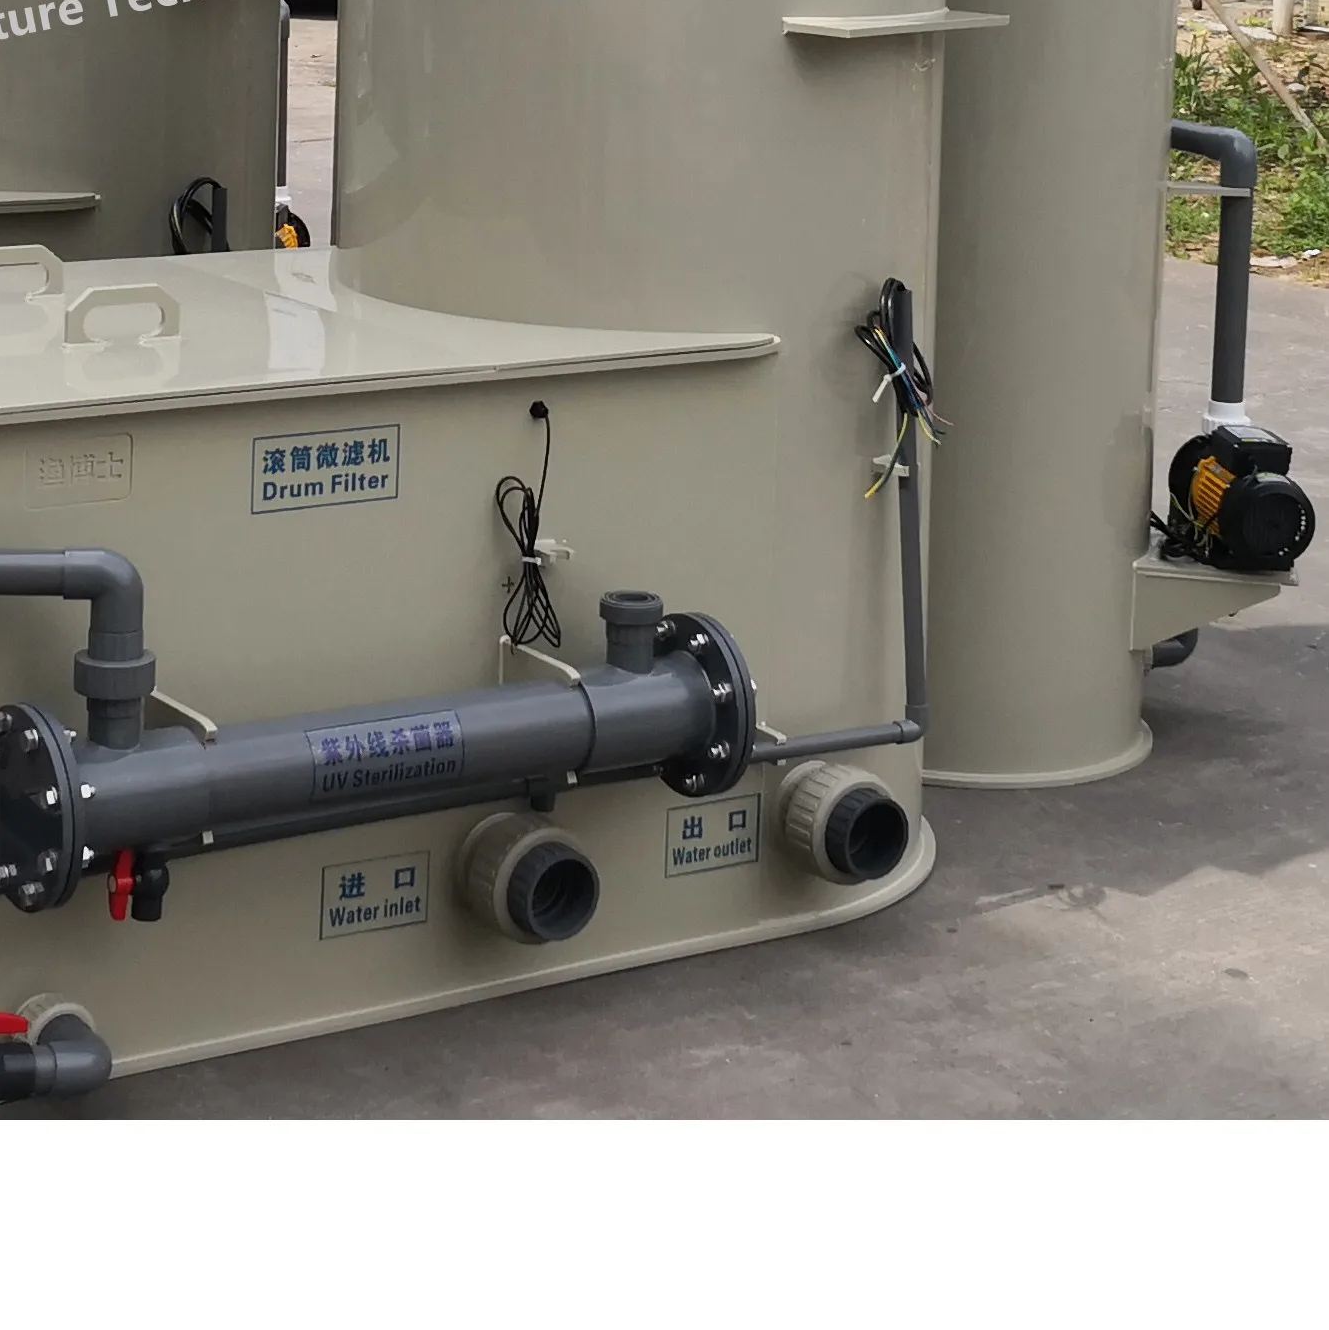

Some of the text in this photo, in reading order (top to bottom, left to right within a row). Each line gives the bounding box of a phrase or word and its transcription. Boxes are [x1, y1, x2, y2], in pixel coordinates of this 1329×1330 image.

[262, 438, 390, 474] 滚筒微滤机
[262, 471, 389, 501] Drum Filter
[320, 720, 455, 767] 紫外线杀菌器
[322, 757, 456, 792] UV Sterilization
[671, 836, 752, 867] Water outlet
[329, 894, 421, 929] Water inlet
